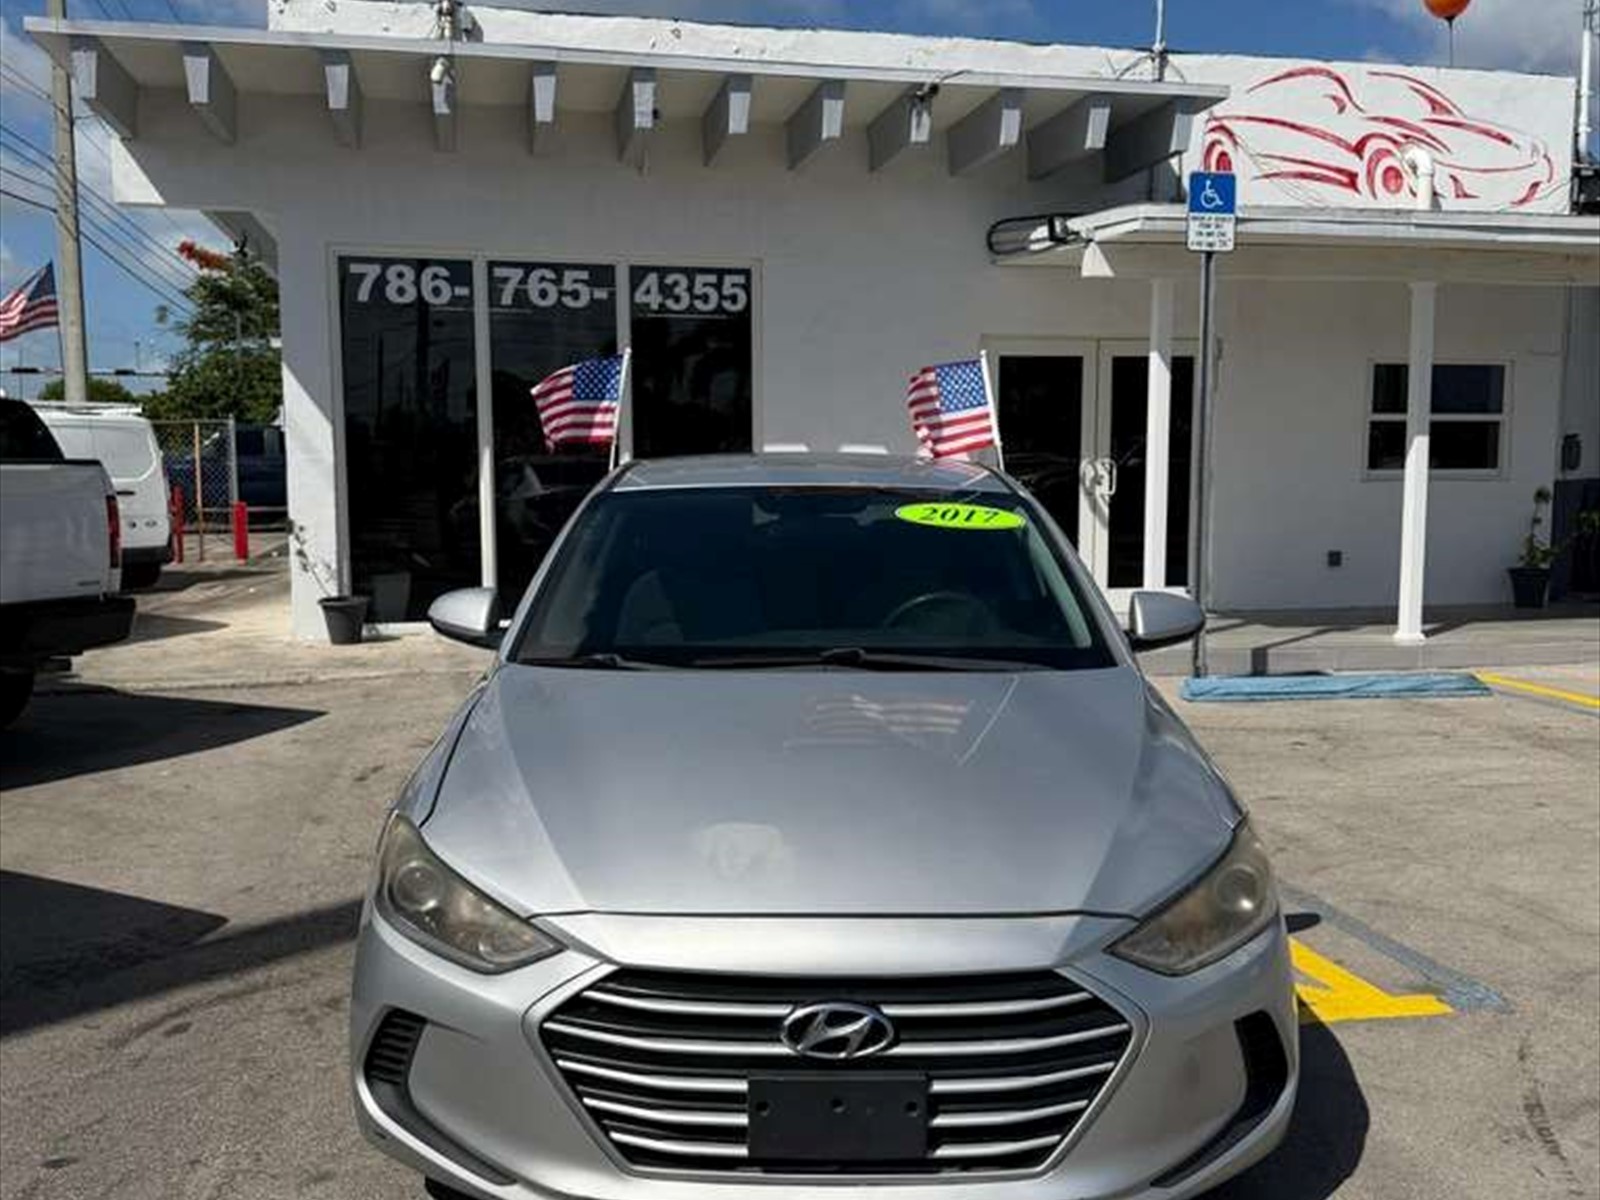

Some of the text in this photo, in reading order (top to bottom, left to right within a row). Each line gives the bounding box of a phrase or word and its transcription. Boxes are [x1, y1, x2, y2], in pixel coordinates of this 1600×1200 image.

[348, 262, 749, 313] 786- 765- 4355
[919, 506, 999, 523] 2017
